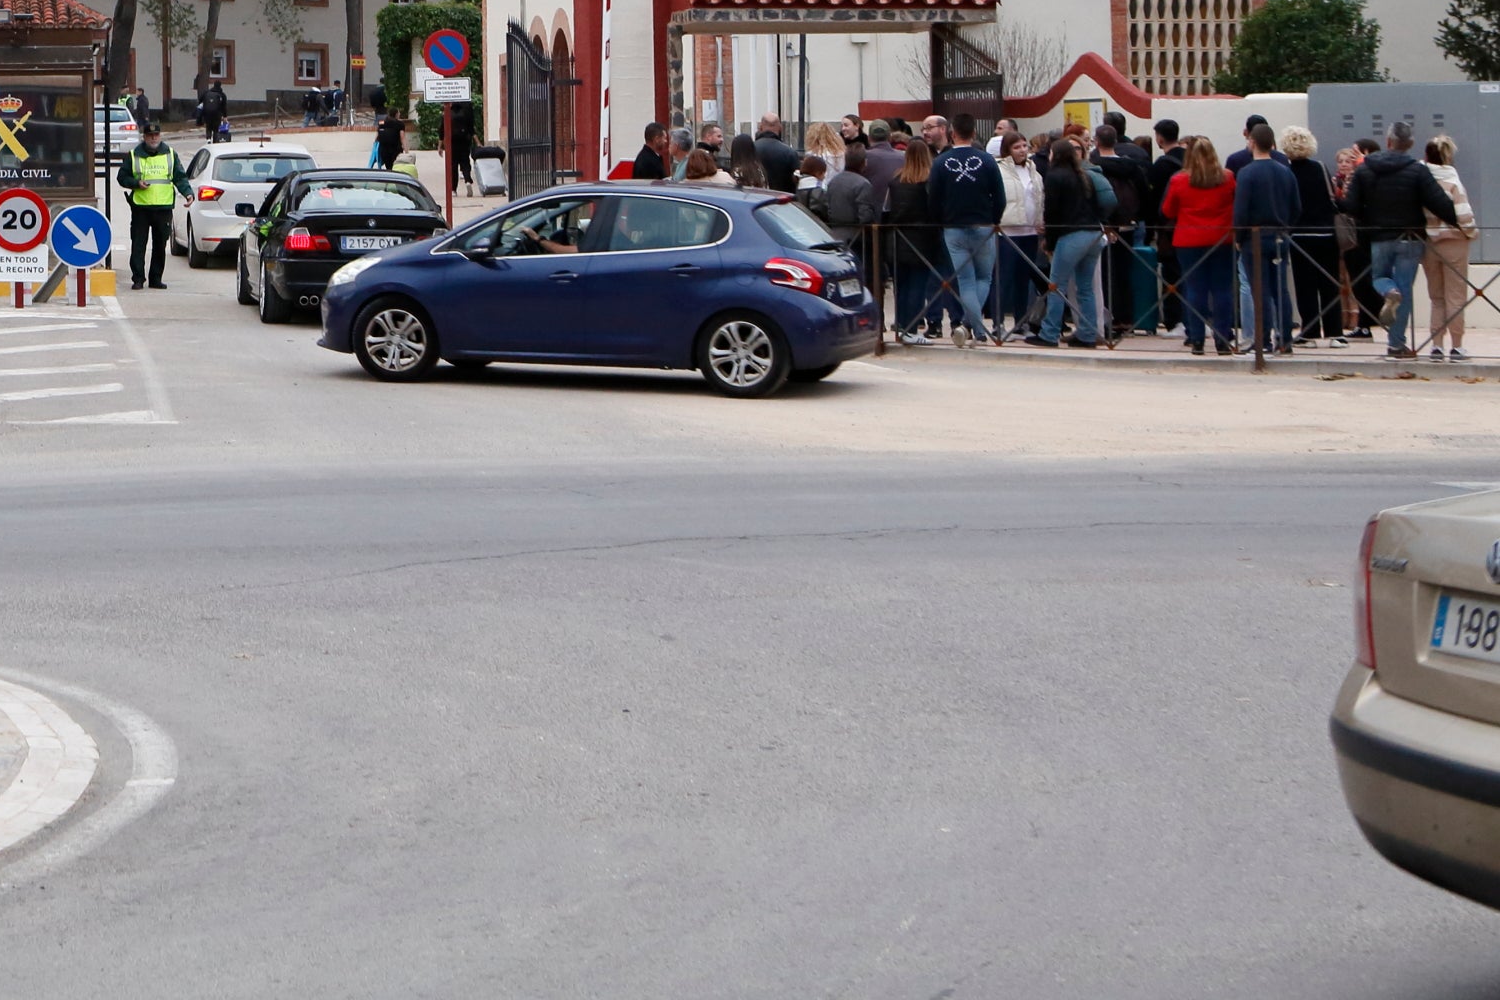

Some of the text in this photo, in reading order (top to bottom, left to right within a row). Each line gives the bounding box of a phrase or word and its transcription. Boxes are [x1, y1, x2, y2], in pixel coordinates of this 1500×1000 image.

[21, 169, 52, 178] CIVIL
[1, 209, 37, 231] 20
[349, 238, 375, 248] 2157
[0, 256, 39, 264] EN TODO
[6, 266, 45, 274] RECINTO
